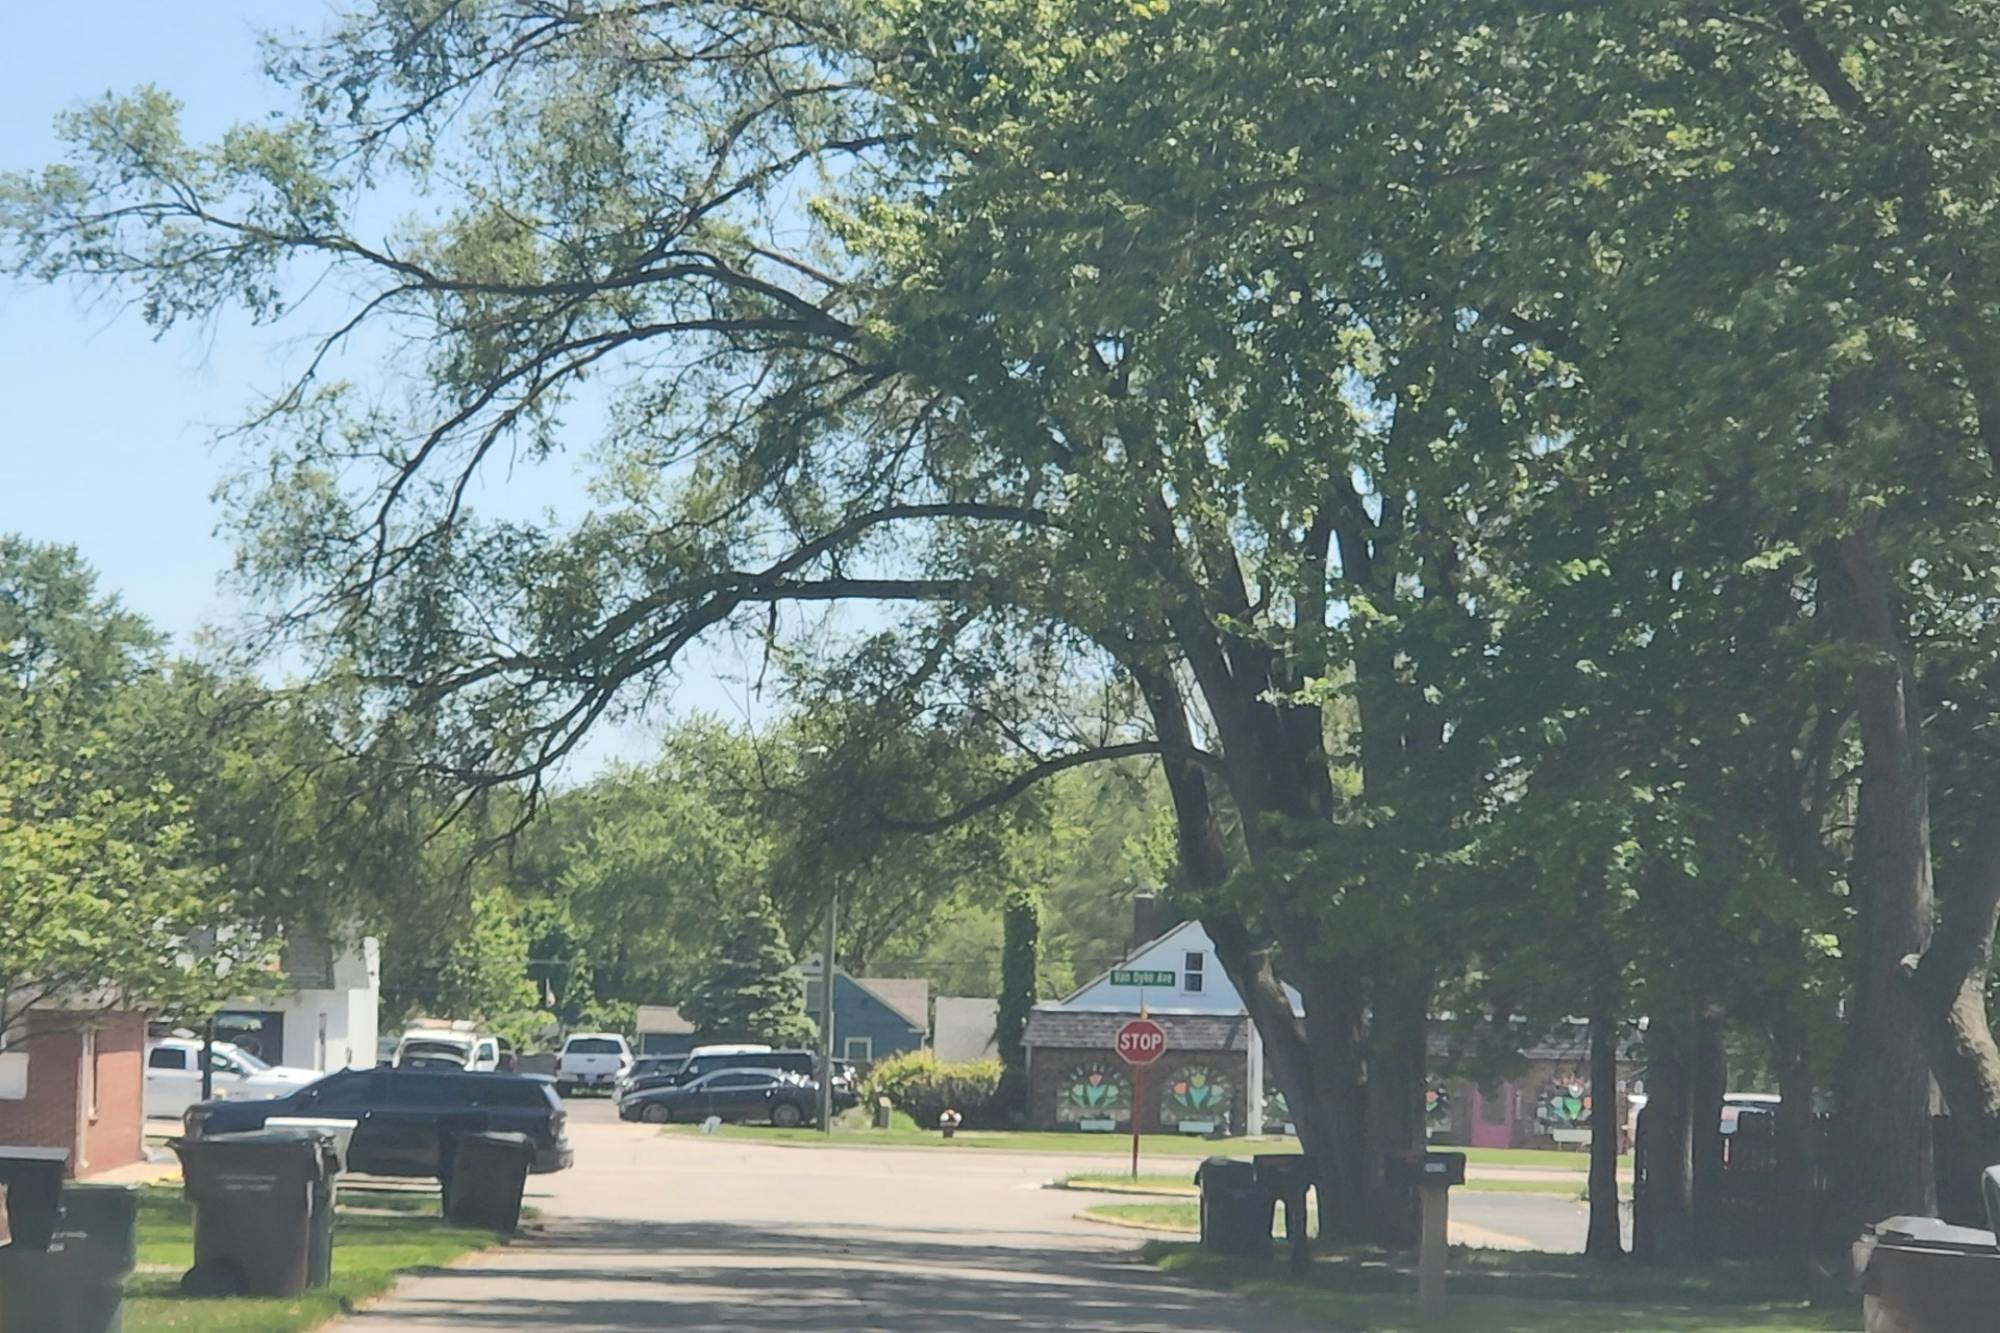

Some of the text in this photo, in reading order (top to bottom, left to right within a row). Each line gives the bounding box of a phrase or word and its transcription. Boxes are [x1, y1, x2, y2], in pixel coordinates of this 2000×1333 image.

[1114, 972, 1173, 985] Van Dyke Ave
[1120, 1033, 1162, 1050] STOP
